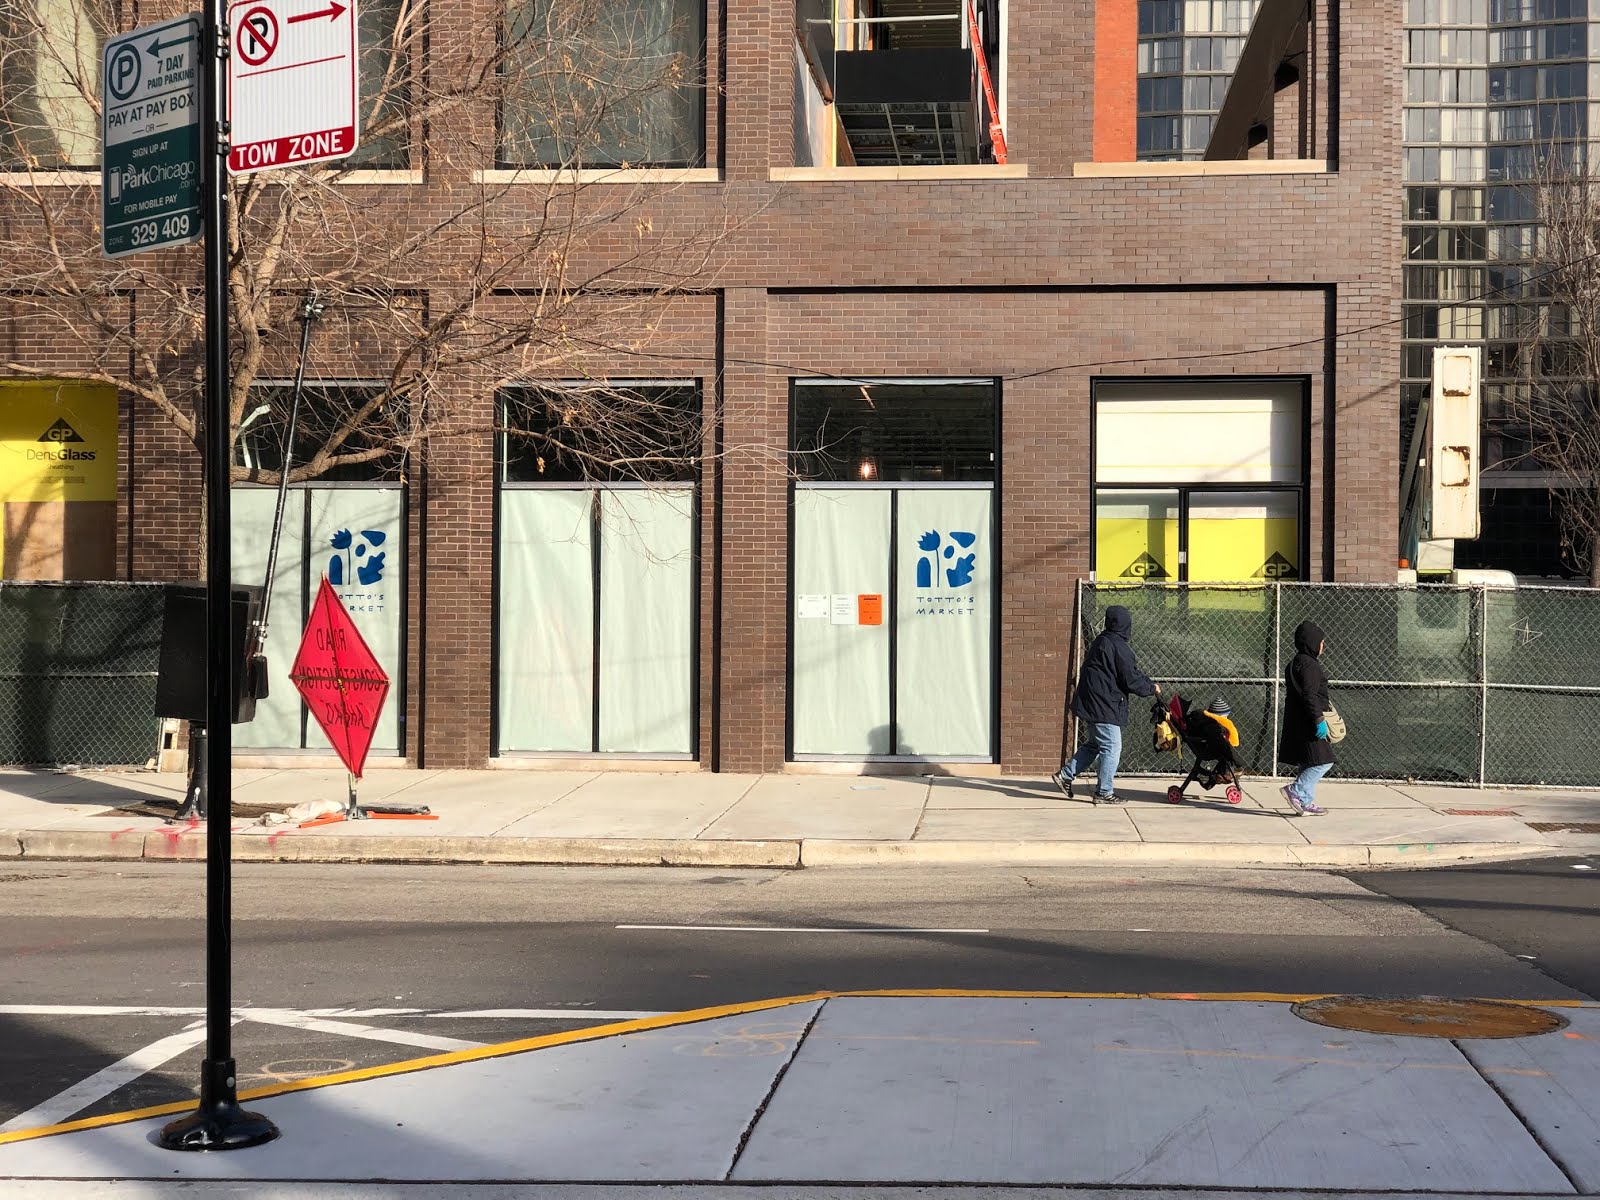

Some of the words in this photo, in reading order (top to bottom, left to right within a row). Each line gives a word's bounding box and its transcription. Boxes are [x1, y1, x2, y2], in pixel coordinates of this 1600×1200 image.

[157, 60, 163, 74] 7
[166, 54, 184, 71] DAY
[147, 77, 163, 89] PAID
[164, 68, 194, 85] PARKING
[109, 110, 129, 128] PAY
[130, 106, 143, 122] AT
[146, 100, 166, 118] PAY
[170, 92, 194, 111] BOX
[145, 123, 155, 133] OR
[132, 146, 148, 158] SIGN
[150, 144, 159, 154] UP
[160, 141, 168, 150] AT
[236, 142, 277, 168] TOW
[288, 130, 343, 160] ZONE
[122, 160, 195, 190] ParkChicago
[124, 204, 137, 214] FOR
[139, 197, 163, 210] MOBILE
[165, 194, 177, 205] PAY
[131, 222, 157, 246] 329
[162, 214, 190, 238] 409
[47, 428, 73, 441] GP
[26, 449, 96, 461] DensGlass
[1130, 563, 1159, 576] GP
[1261, 563, 1290, 576] GP
